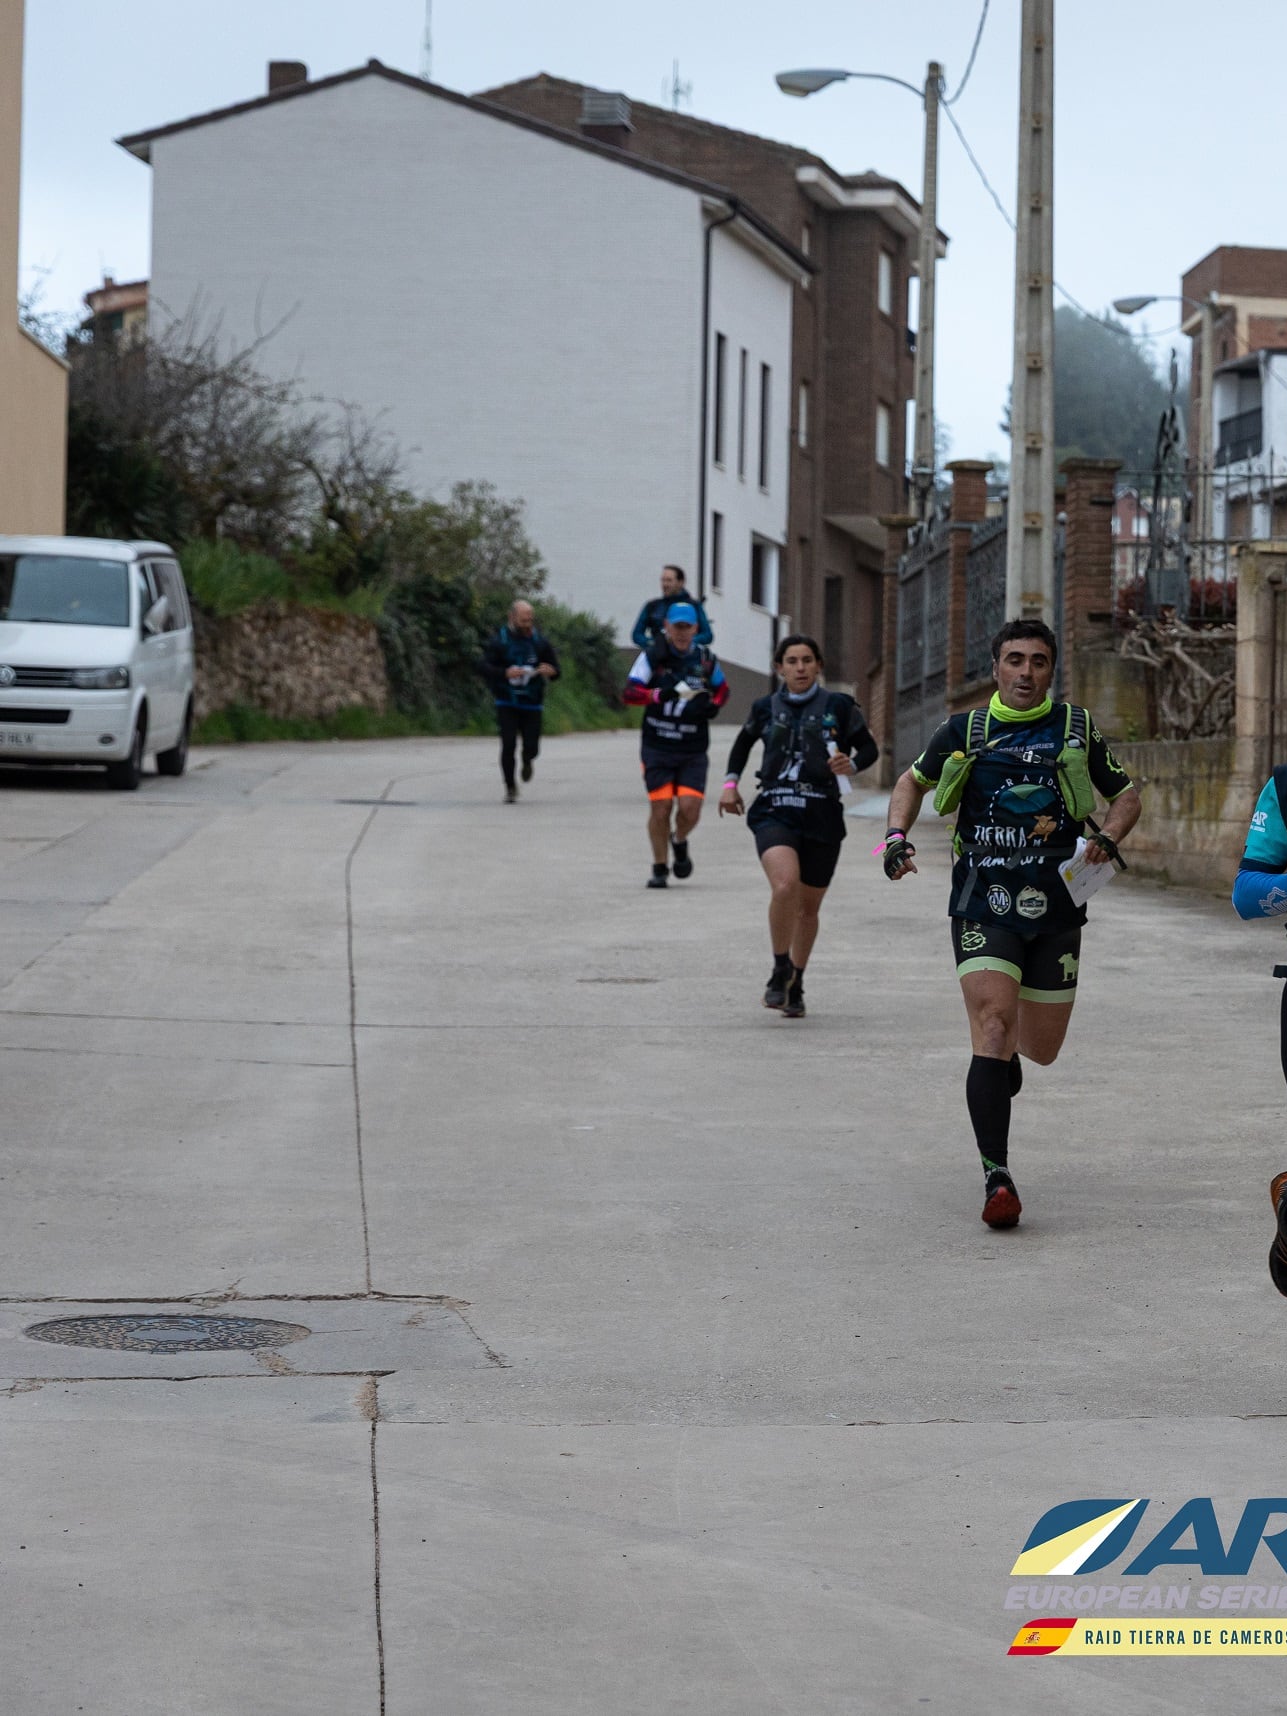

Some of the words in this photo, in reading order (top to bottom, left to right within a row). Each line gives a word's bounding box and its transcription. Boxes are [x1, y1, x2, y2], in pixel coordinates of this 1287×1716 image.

[1026, 742, 1055, 752] SERIES
[1005, 774, 1054, 787] RAID
[974, 825, 1027, 848] TIERRA
